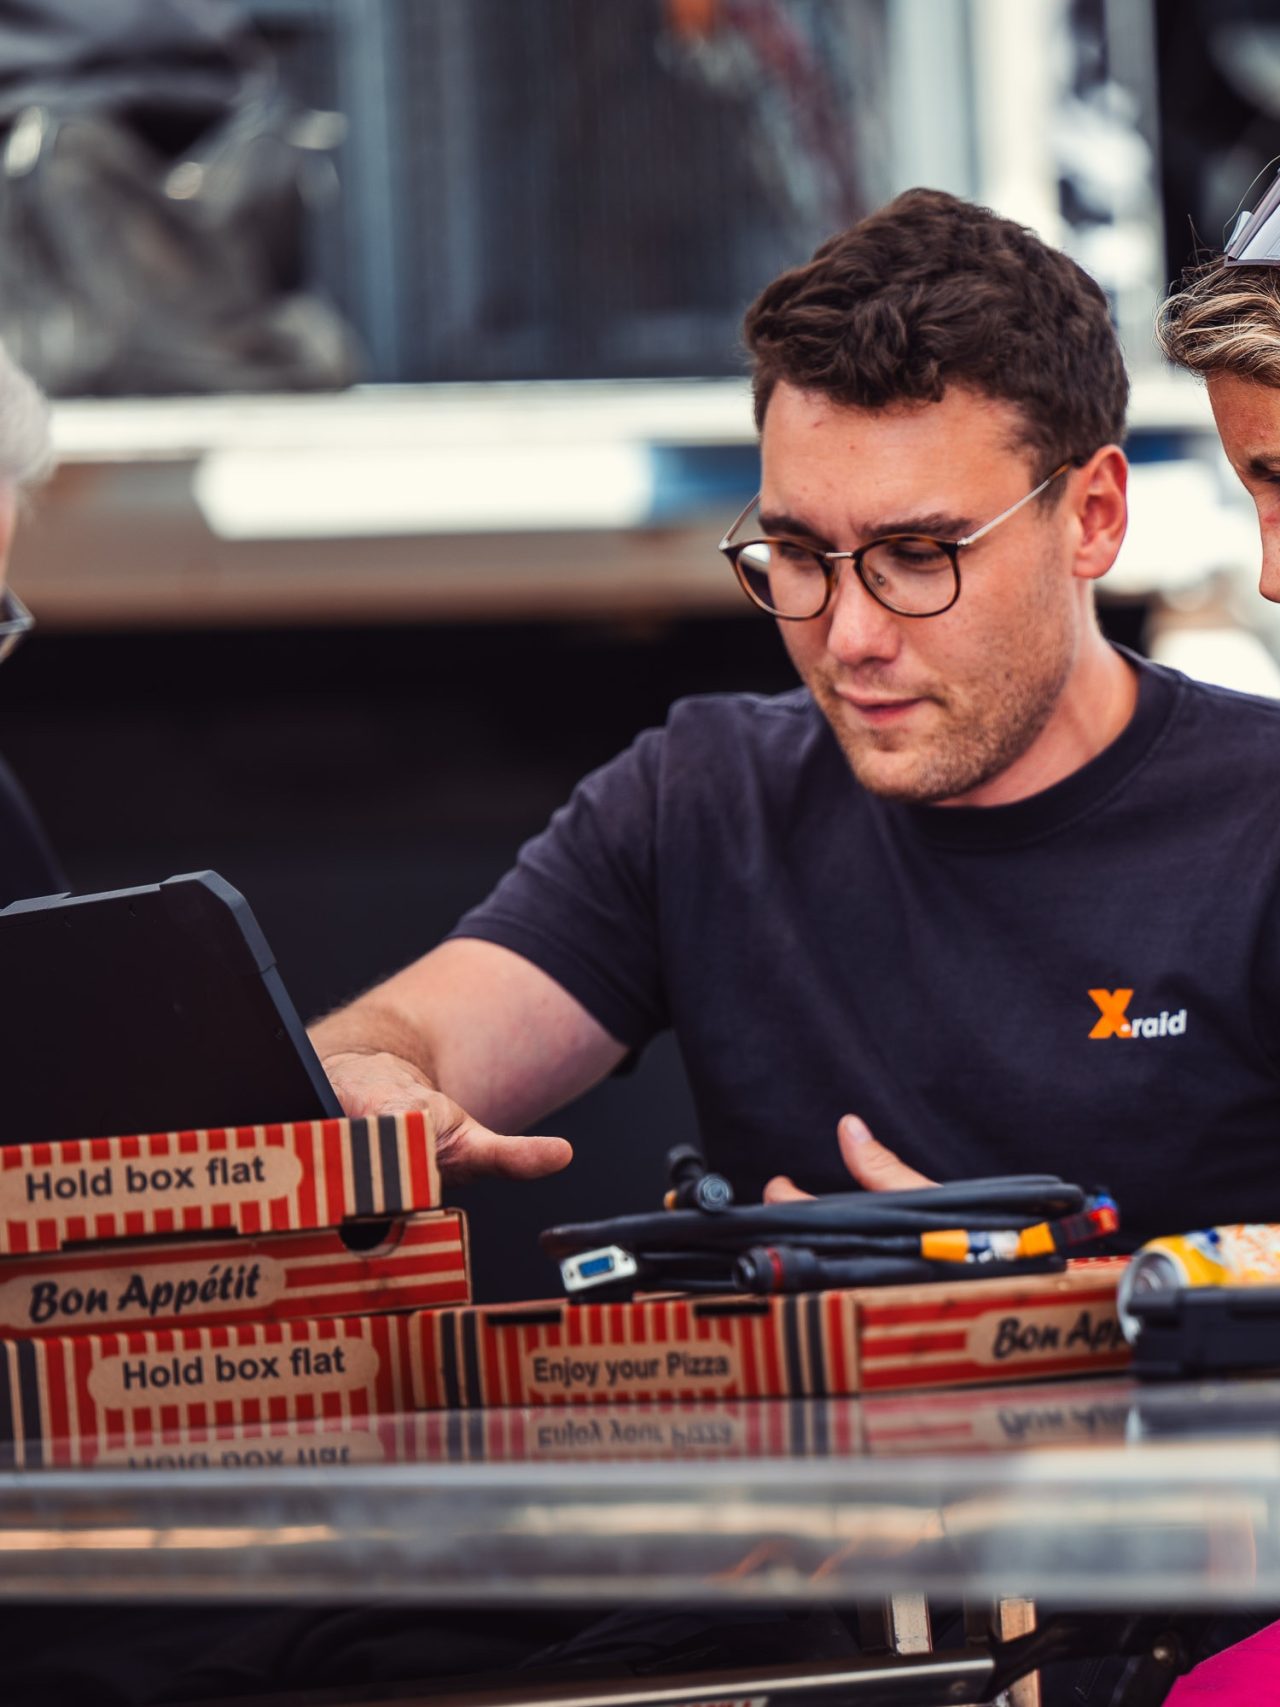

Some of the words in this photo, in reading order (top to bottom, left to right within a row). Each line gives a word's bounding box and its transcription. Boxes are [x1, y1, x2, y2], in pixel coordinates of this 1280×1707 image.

[1087, 988, 1187, 1039] X-raid
[26, 1167, 112, 1202] Hold
[126, 1164, 195, 1193] box
[206, 1155, 265, 1187] flat
[29, 1281, 108, 1323] Bon
[117, 1264, 260, 1315] Appétit
[993, 1317, 1059, 1359] Bon
[123, 1356, 203, 1390] Hold
[215, 1354, 280, 1382] box
[290, 1346, 345, 1377] flat
[533, 1356, 598, 1388] Enjoy
[605, 1357, 659, 1386] your
[666, 1351, 729, 1378] Pizza
